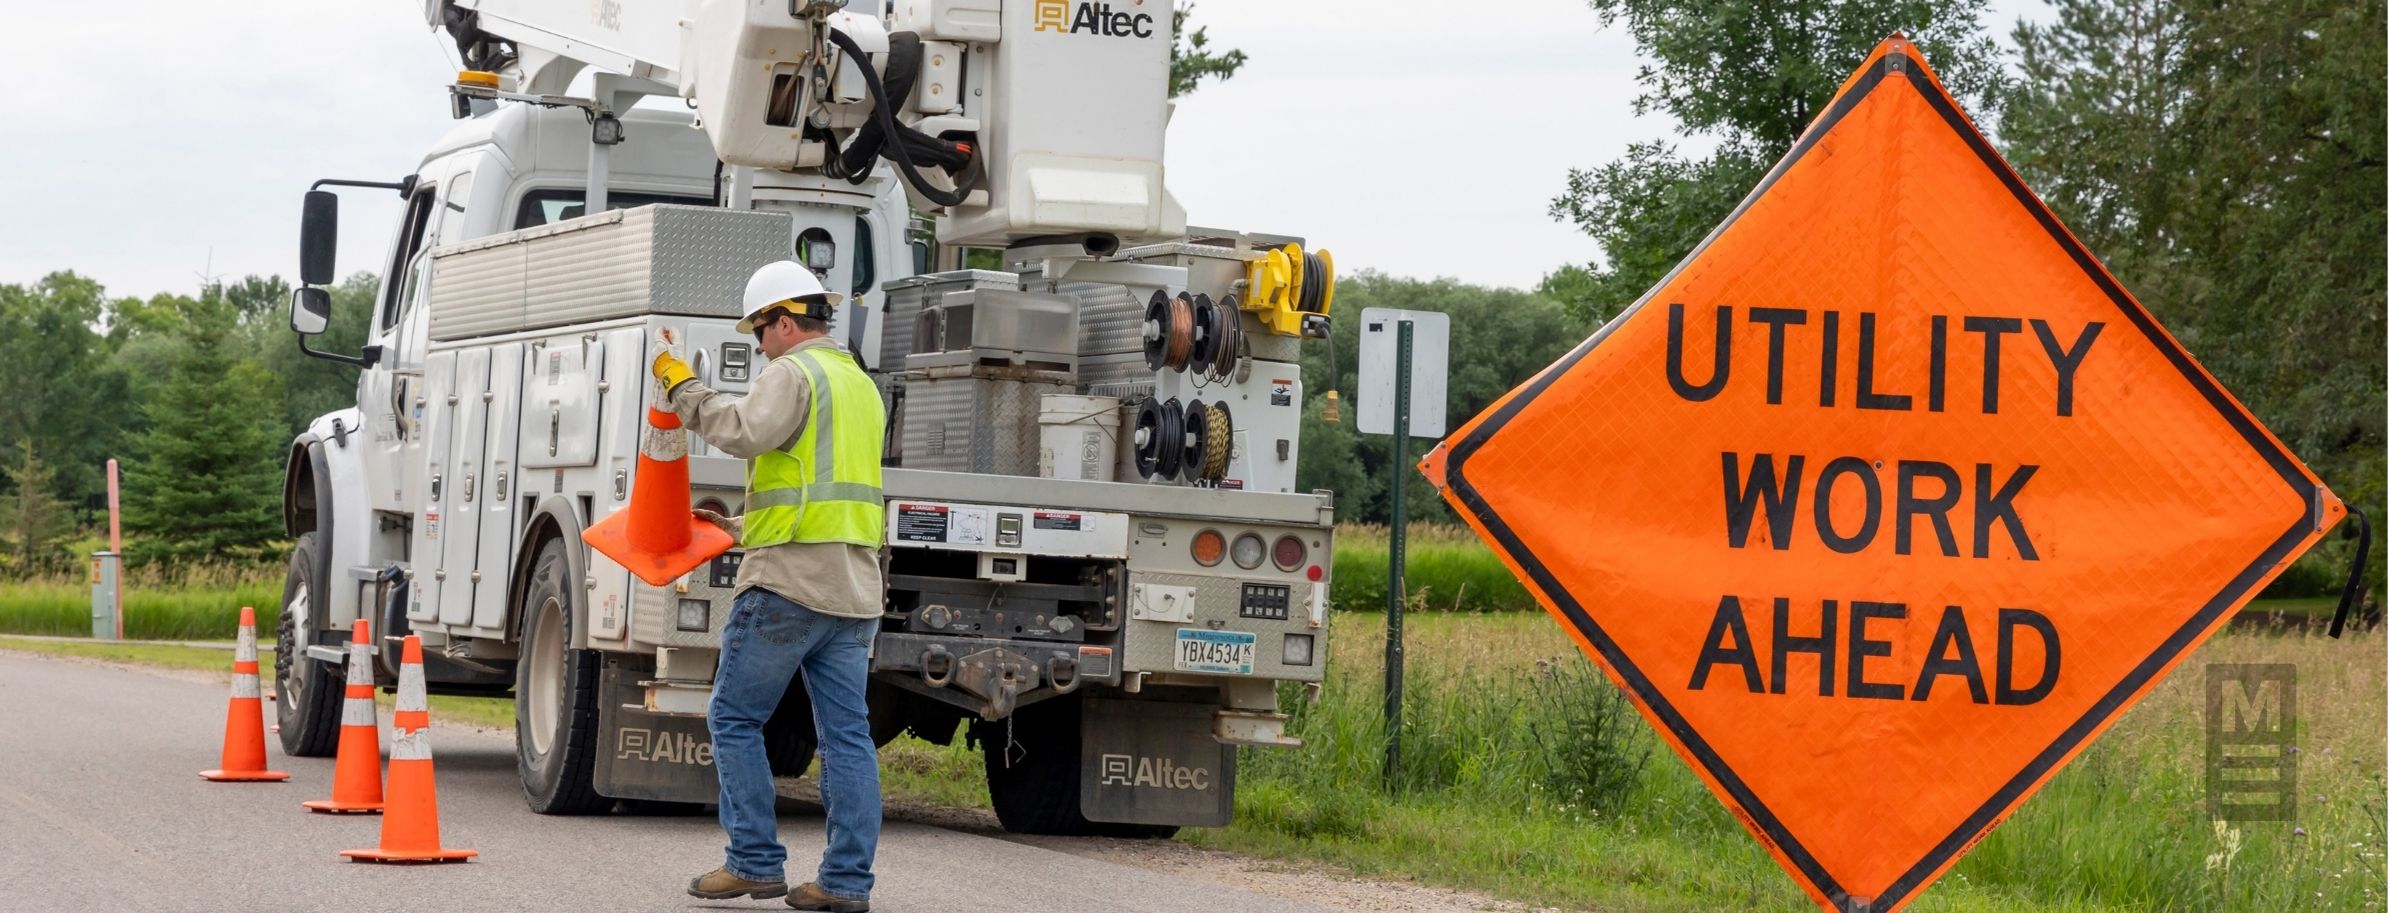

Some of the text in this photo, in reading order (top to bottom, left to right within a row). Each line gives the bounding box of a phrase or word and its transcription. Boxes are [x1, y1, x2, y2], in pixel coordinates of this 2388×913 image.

[1070, 1, 1153, 38] Altec
[1666, 303, 2106, 417] UTILITY
[1721, 451, 2041, 561] WORK
[1182, 640, 1240, 665] YBX4534
[1243, 644, 1251, 656] K
[1687, 594, 2062, 706] AHEAD
[651, 731, 713, 766] Alte
[1133, 757, 1209, 790] Altec
